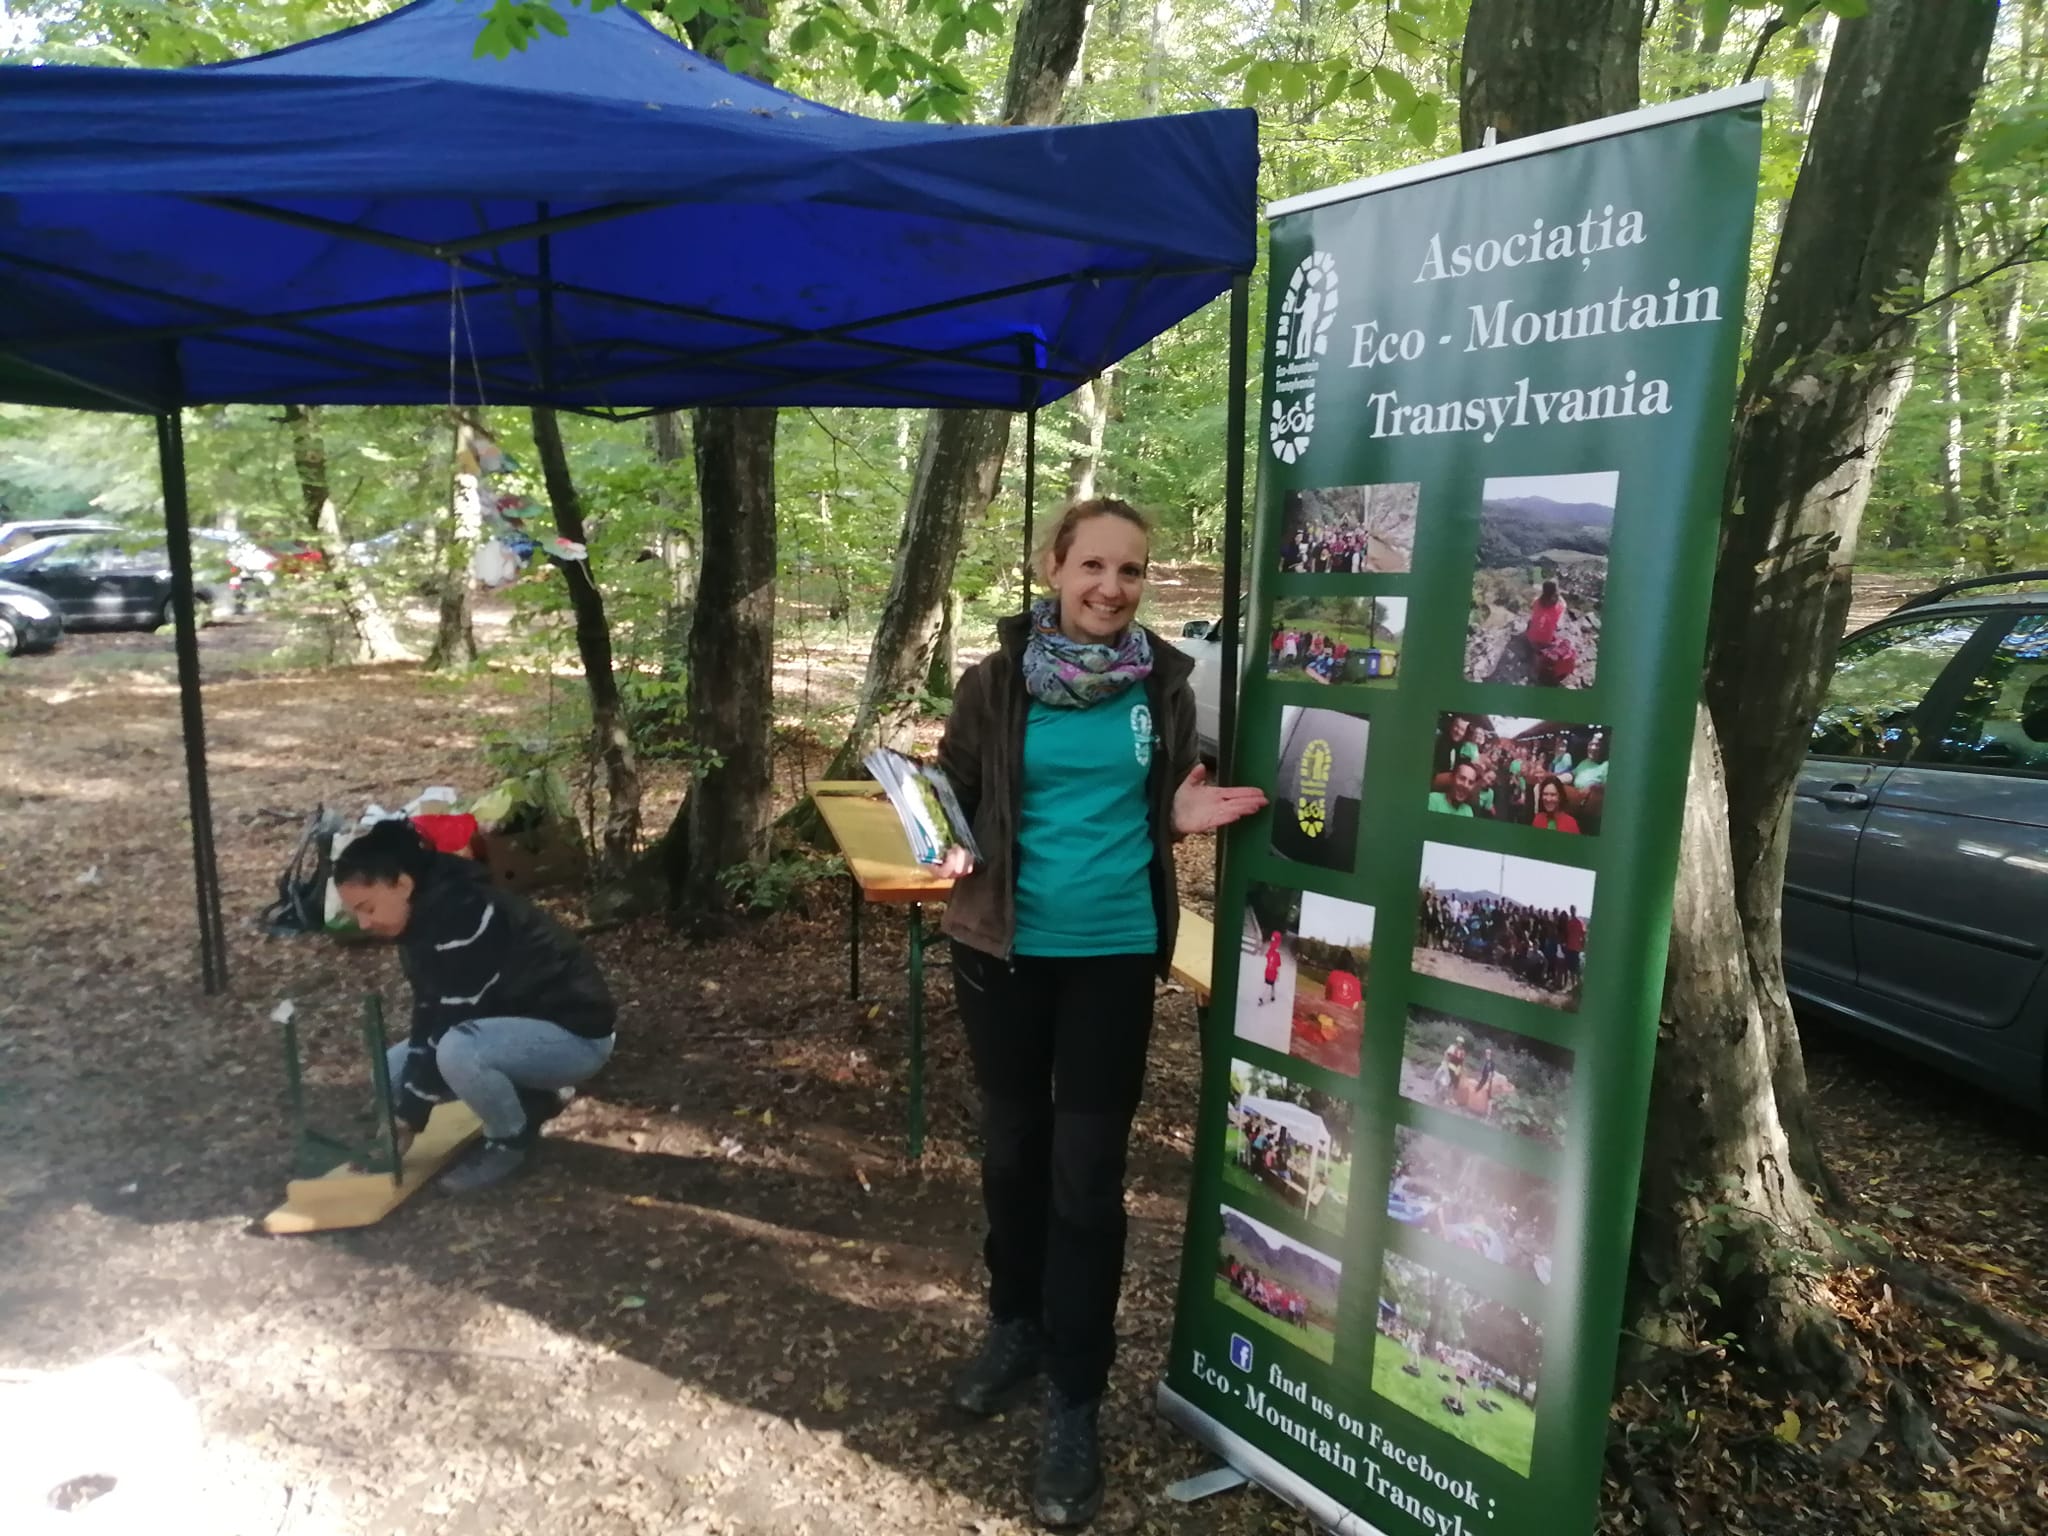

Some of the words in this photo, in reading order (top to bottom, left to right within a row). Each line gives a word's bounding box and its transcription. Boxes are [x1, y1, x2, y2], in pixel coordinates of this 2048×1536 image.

[1413, 204, 1647, 284] Asociația
[1348, 321, 1426, 369] Eco
[1464, 277, 1723, 353] Mountain
[1366, 369, 1672, 443] Transylvania
[1192, 1350, 1230, 1394] Eco
[1244, 1383, 1357, 1478] Mountain
[1268, 1363, 1307, 1405] find
[1311, 1395, 1333, 1421] us
[1337, 1412, 1364, 1440] on
[1368, 1422, 1480, 1510] Facebook
